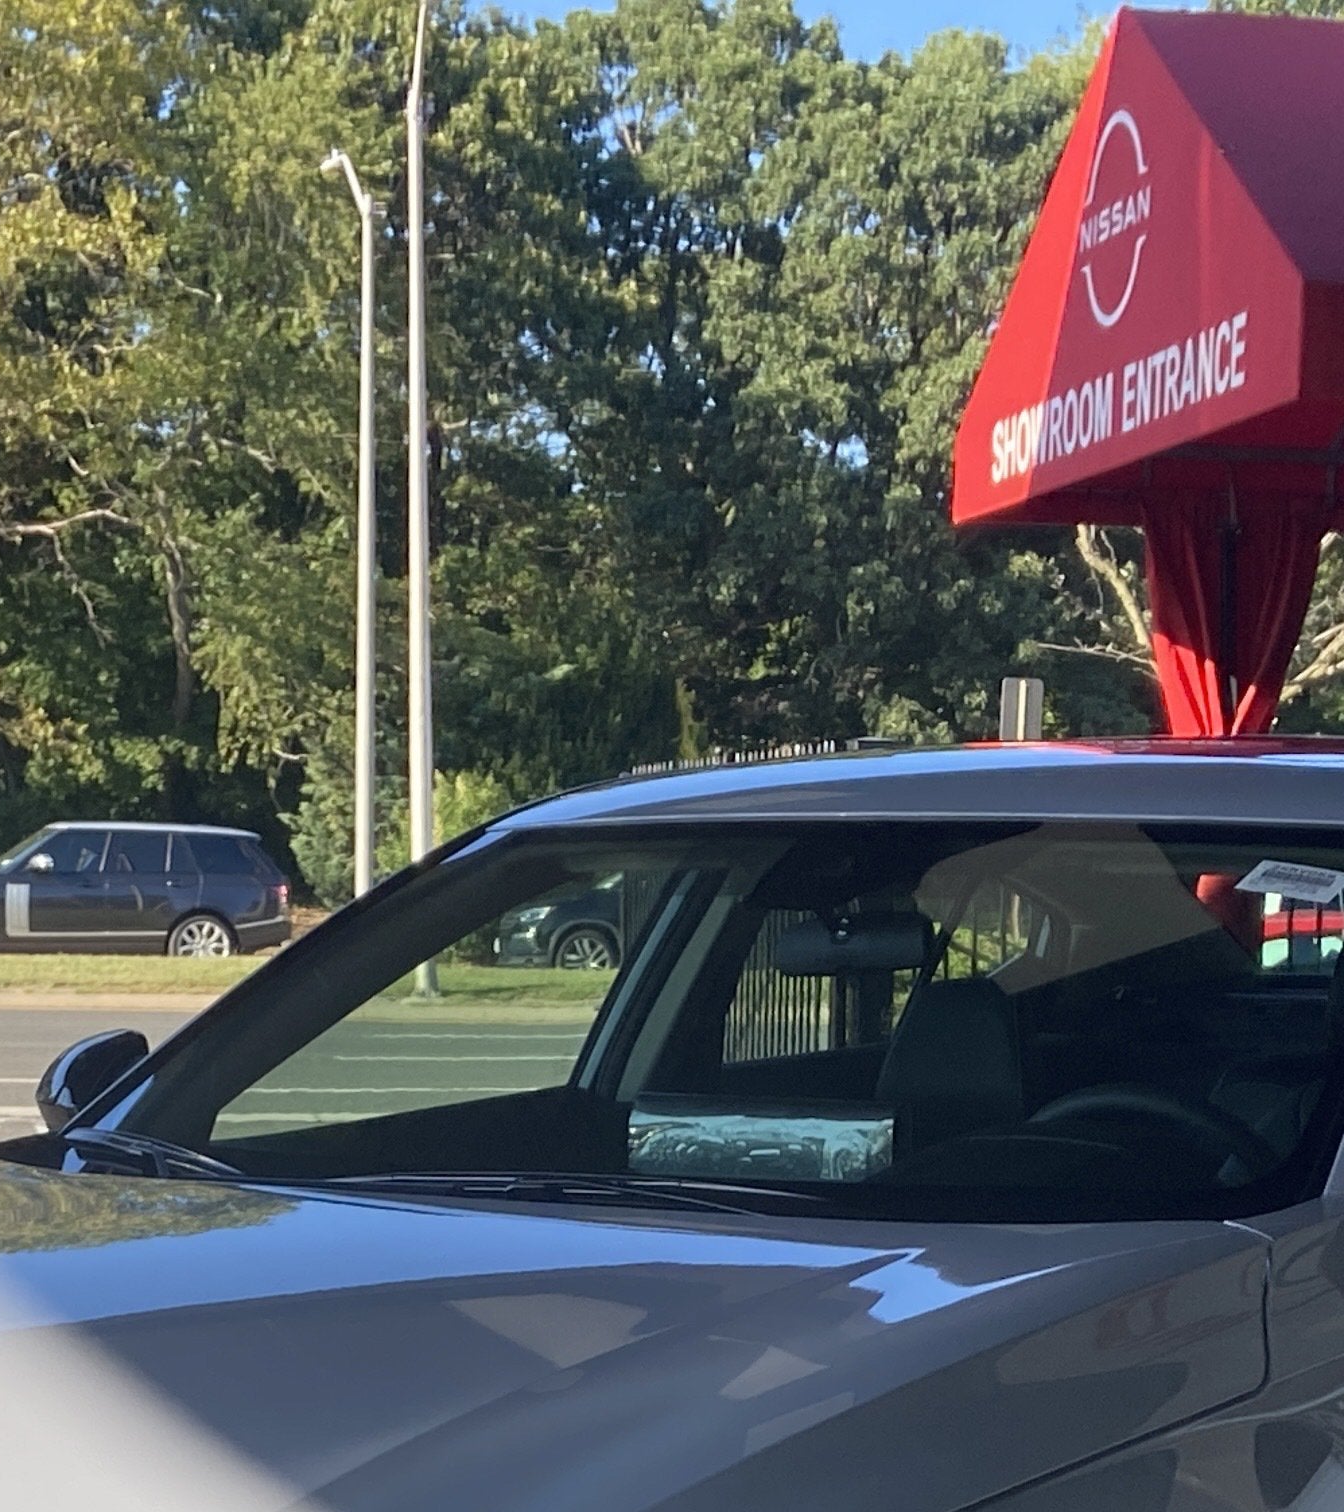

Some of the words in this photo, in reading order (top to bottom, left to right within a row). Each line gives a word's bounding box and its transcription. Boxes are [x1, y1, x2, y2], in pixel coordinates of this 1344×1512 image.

[1079, 185, 1151, 251] NISSAN
[991, 371, 1113, 484] SHOWROOM
[1121, 310, 1248, 433] ENTRANCE
